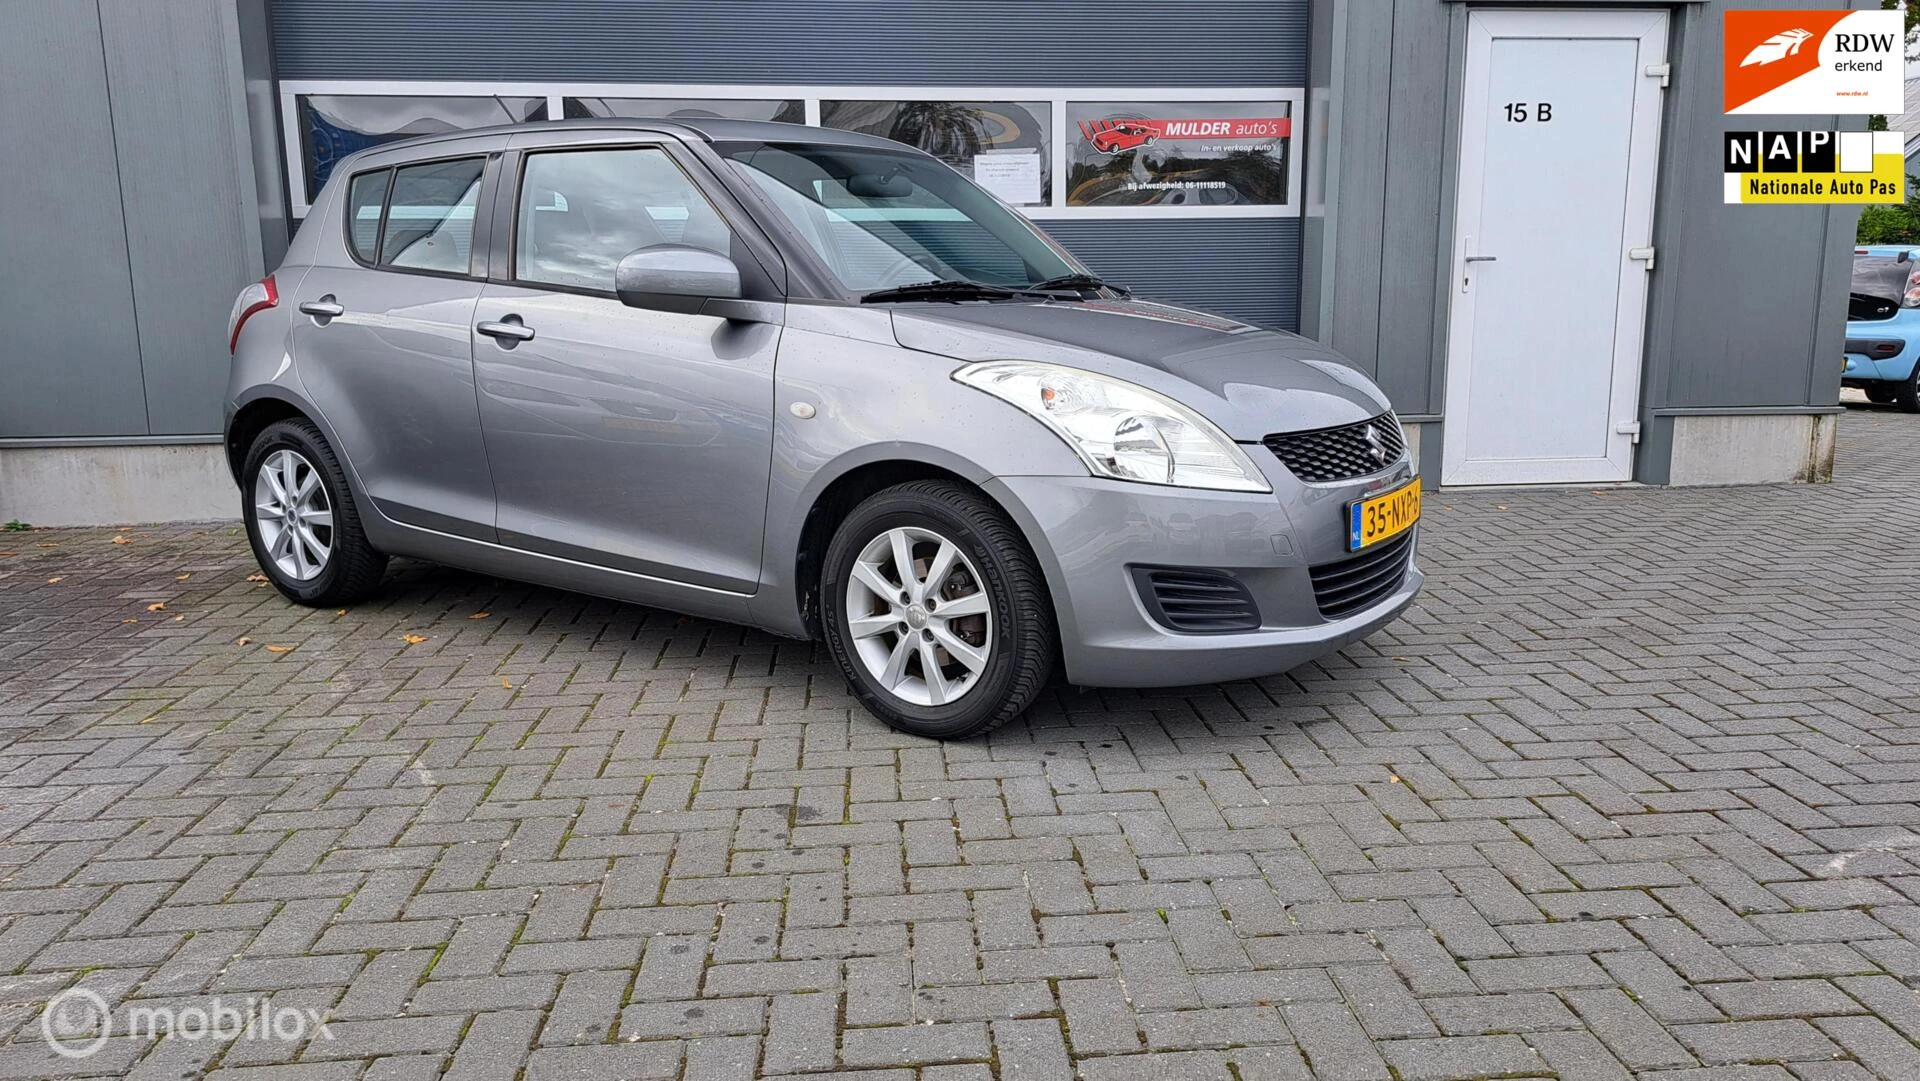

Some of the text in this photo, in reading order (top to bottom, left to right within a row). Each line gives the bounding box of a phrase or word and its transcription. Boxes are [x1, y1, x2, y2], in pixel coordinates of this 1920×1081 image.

[1504, 102, 1552, 123] 15 B
[1165, 121, 1278, 136] MULDER auto's
[1223, 144, 1254, 153] verkoop
[1254, 143, 1276, 151] auto's
[1127, 181, 1226, 192] Bij afwezigheid: 06-11118519
[1367, 487, 1418, 538] 35-NXP-6
[1352, 531, 1360, 541] NL
